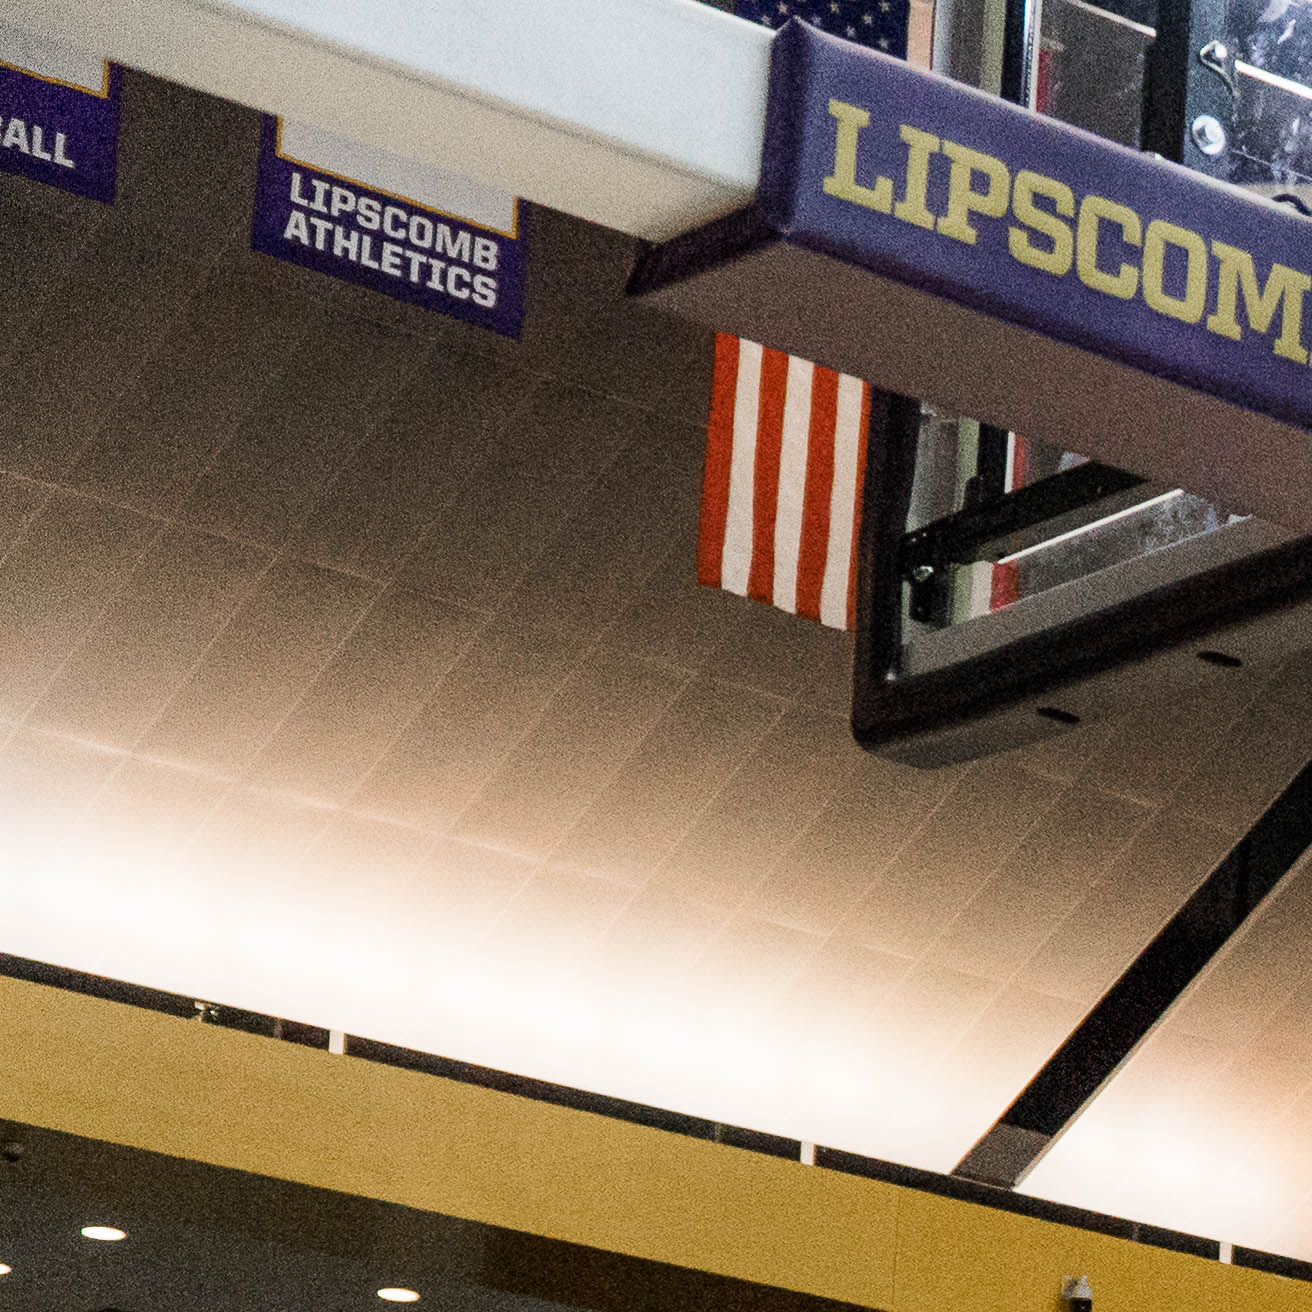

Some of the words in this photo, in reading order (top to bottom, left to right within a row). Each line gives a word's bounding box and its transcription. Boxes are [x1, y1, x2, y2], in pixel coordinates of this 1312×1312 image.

[0, 116, 76, 168] ALL
[283, 210, 498, 308] ATHLETICS
[290, 172, 499, 271] LIPSCOMB
